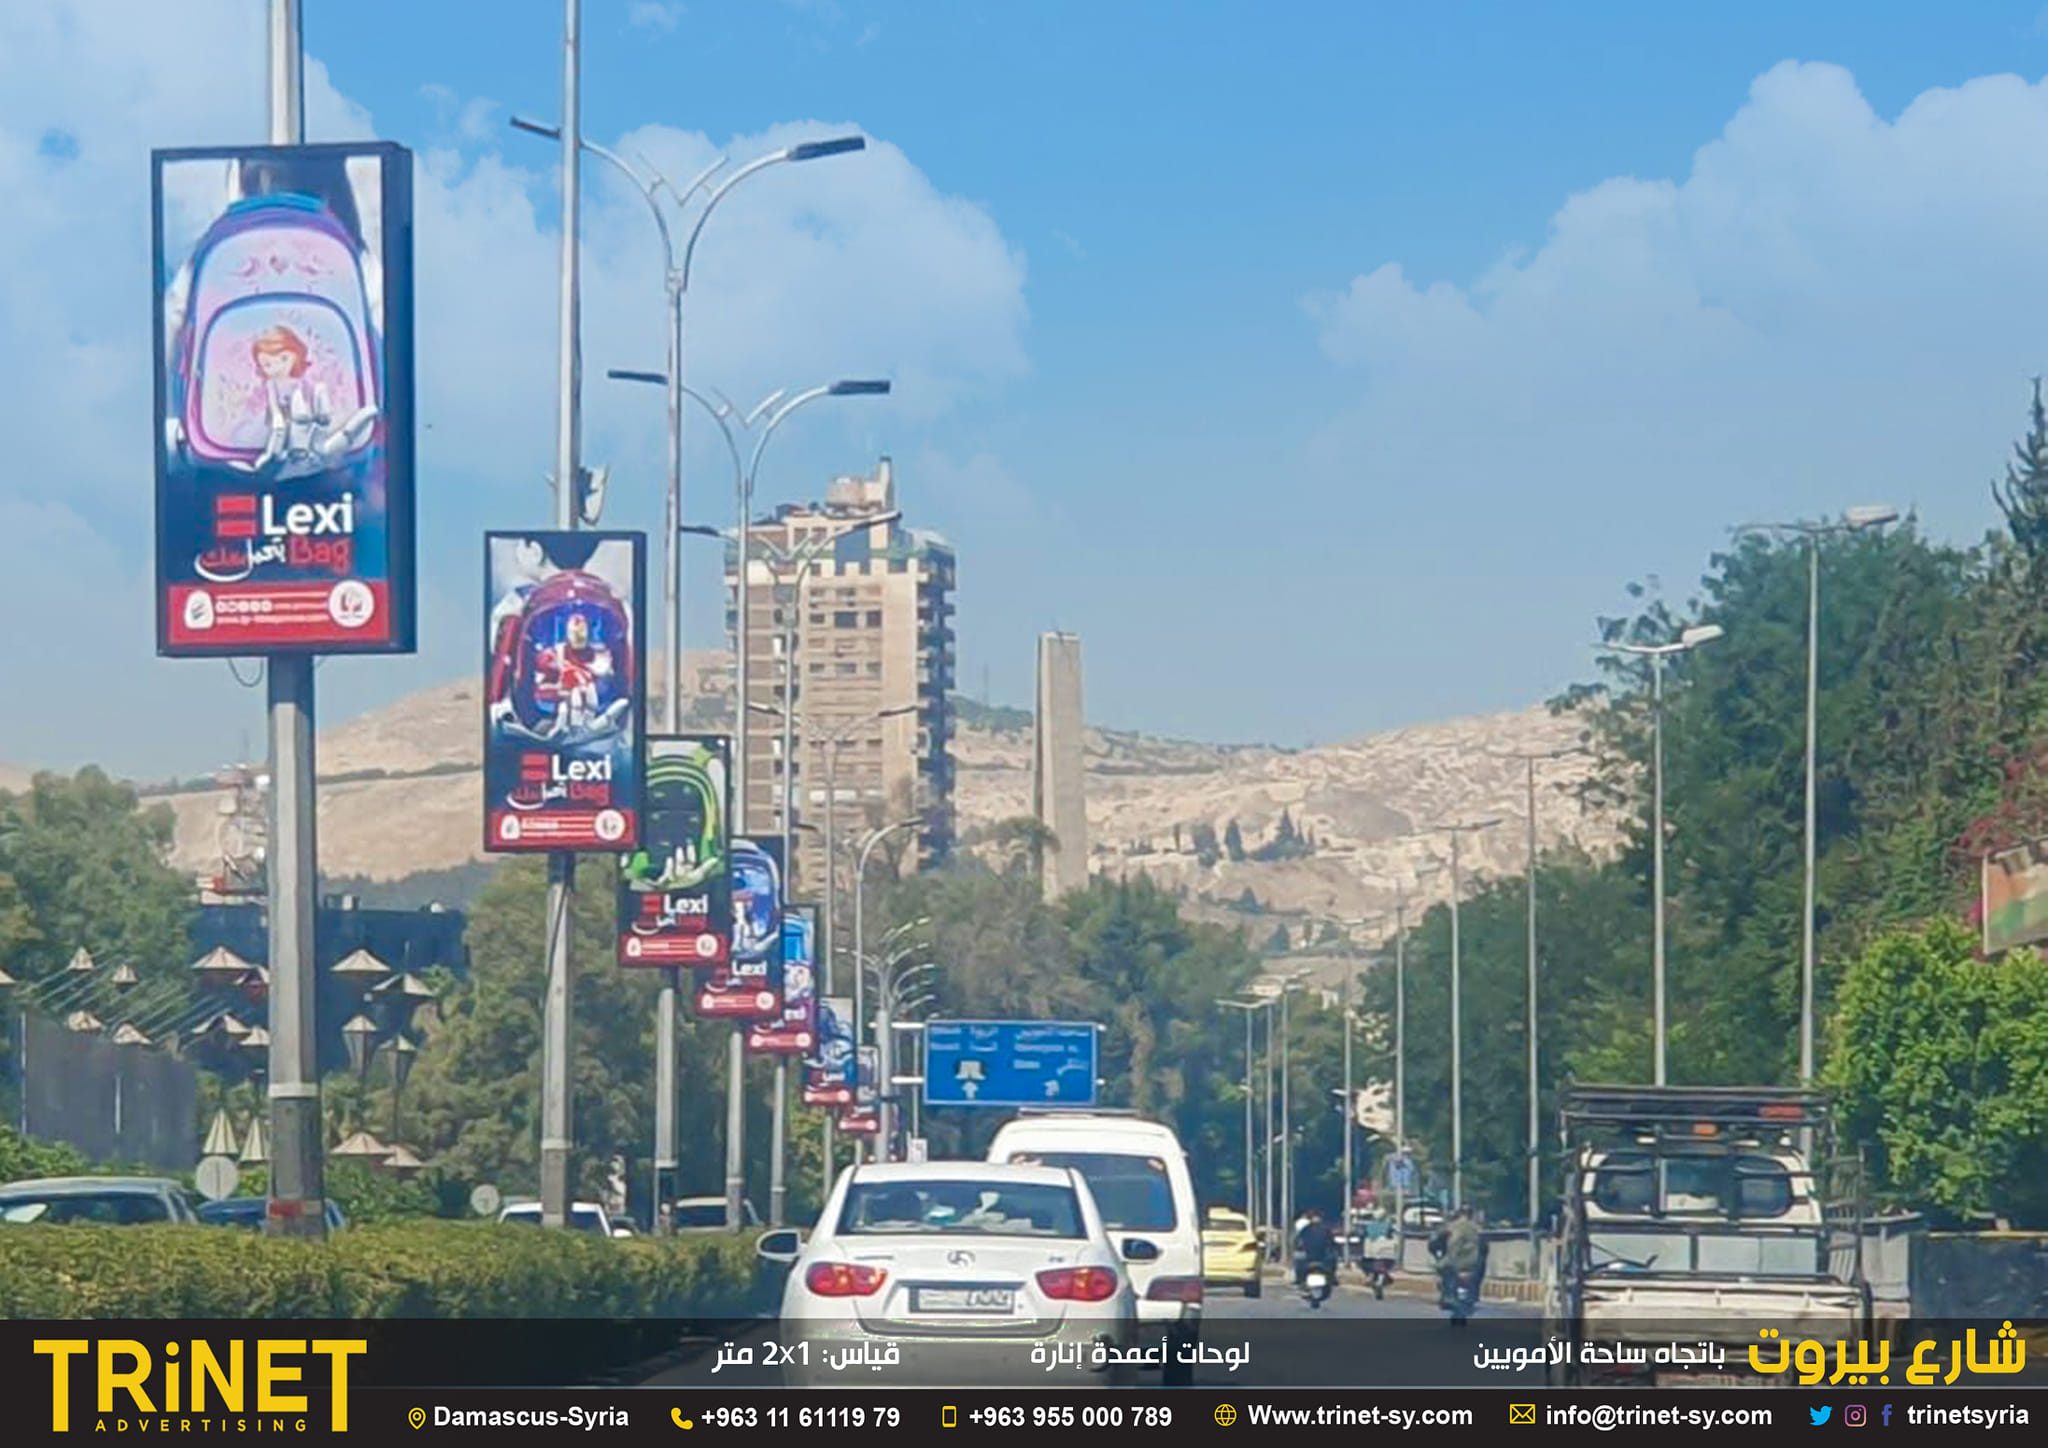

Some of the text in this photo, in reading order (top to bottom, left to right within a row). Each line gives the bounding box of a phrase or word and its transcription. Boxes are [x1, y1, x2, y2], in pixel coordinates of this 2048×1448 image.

[263, 492, 354, 536] Lexi
[288, 536, 351, 575] Bag
[552, 754, 612, 781] Lexi
[664, 894, 709, 914] Lexi
